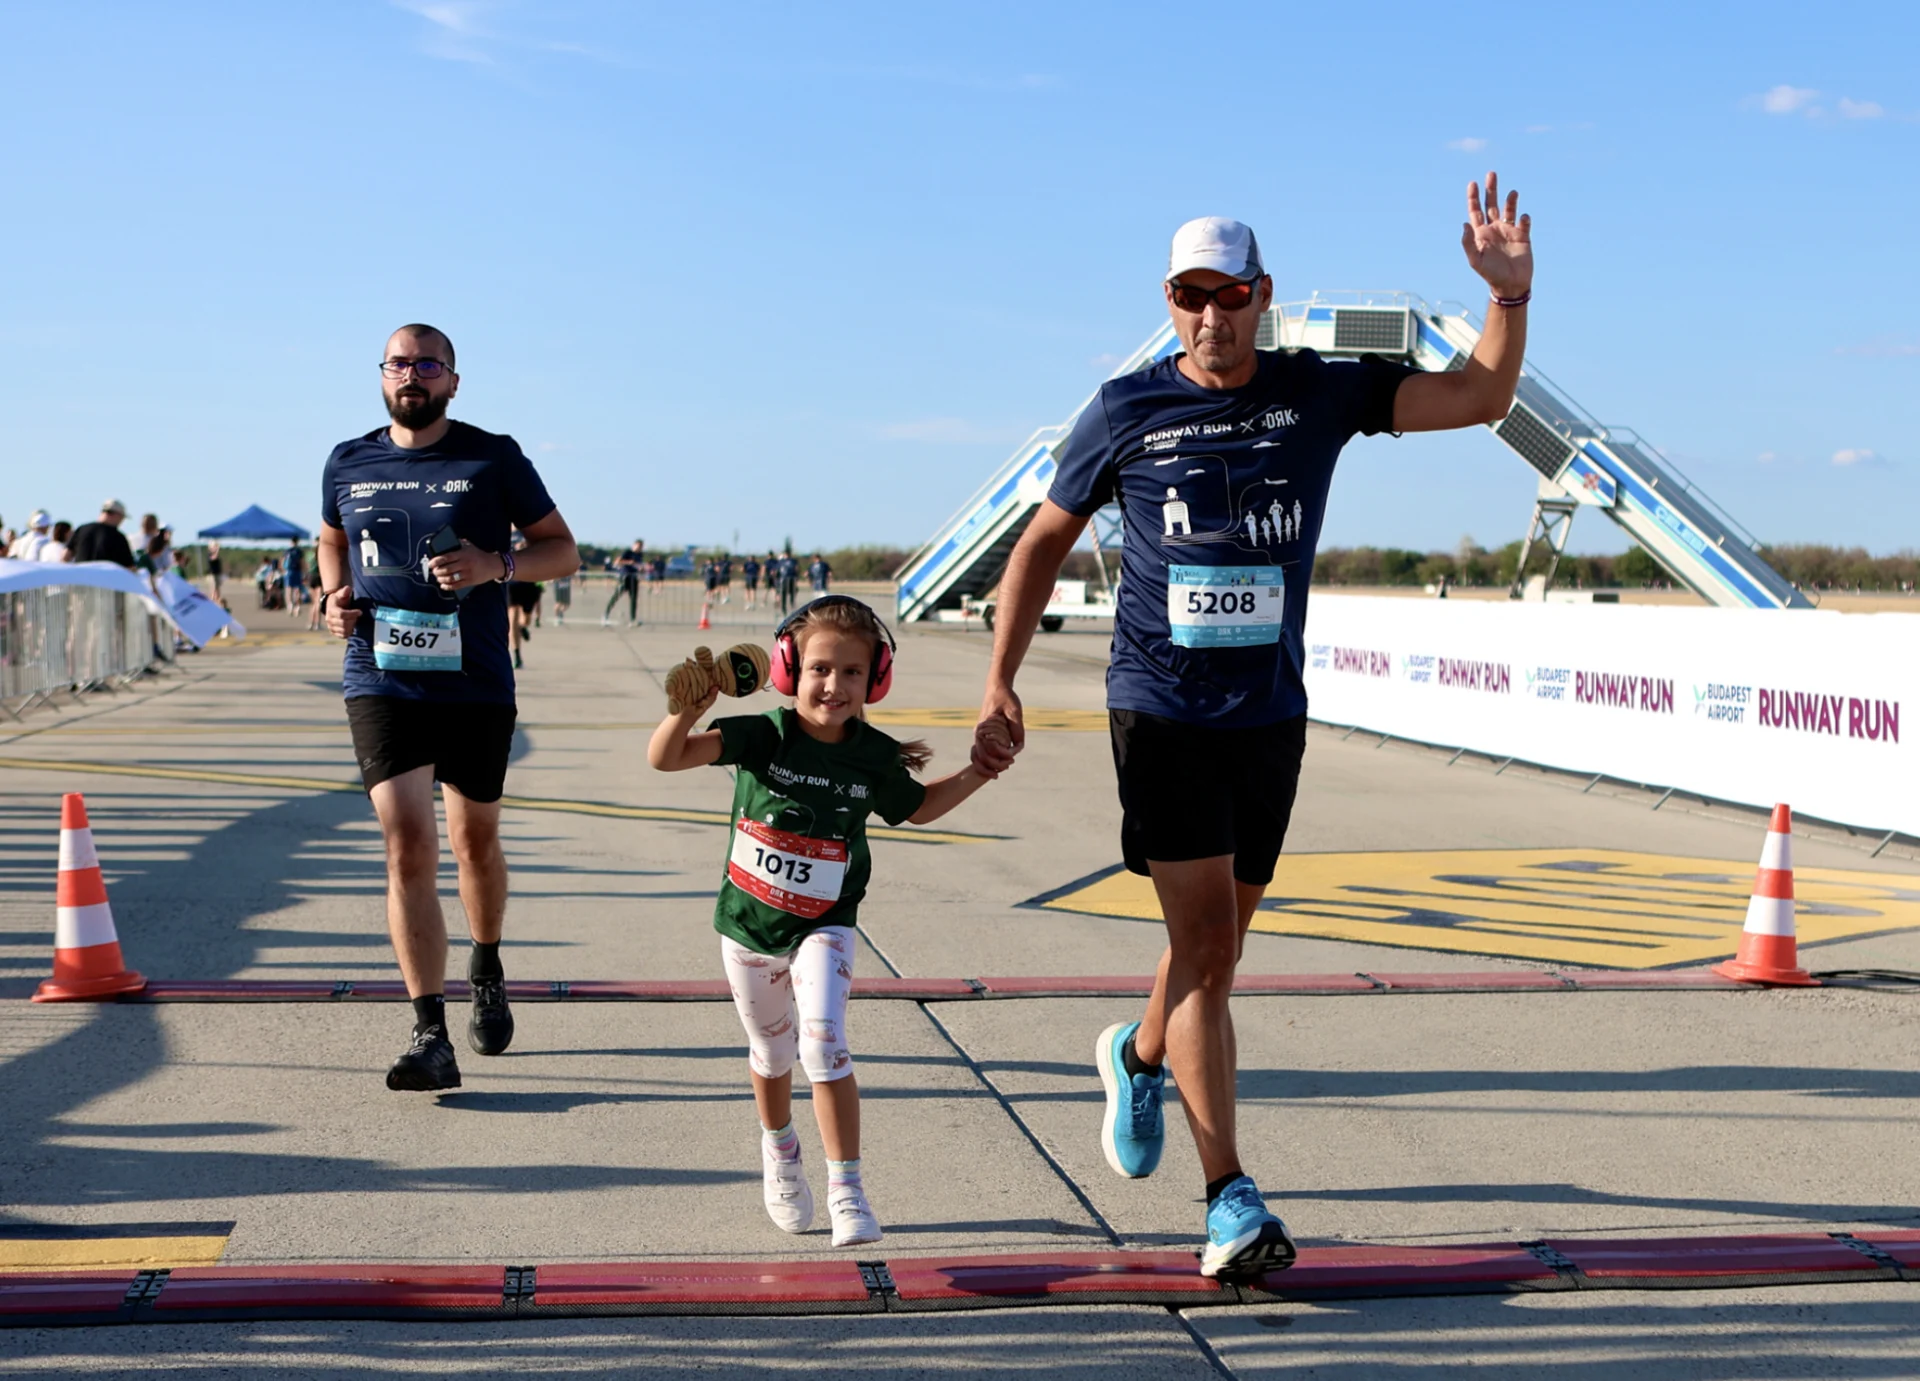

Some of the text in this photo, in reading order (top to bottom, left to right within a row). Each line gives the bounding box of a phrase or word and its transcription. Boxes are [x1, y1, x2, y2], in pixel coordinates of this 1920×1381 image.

[1144, 425, 1200, 443] RUNWAY
[1203, 424, 1232, 435] RUN
[351, 481, 394, 492] RUNWAY
[396, 481, 419, 490] RUN
[1187, 592, 1256, 614] 5208
[389, 628, 439, 649] 5667
[1334, 646, 1390, 677] RUNWAY RUN
[1439, 657, 1510, 694] RUNWAY RUN
[1537, 666, 1571, 683] BUDAPEST
[1576, 670, 1674, 715] RUNWAY RUN
[1708, 683, 1752, 703] BUDAPEST
[1759, 687, 1900, 744] RUNWAY RUN
[769, 762, 806, 784] RUNAY
[807, 776, 830, 787] RUN
[755, 847, 813, 885] 1013
